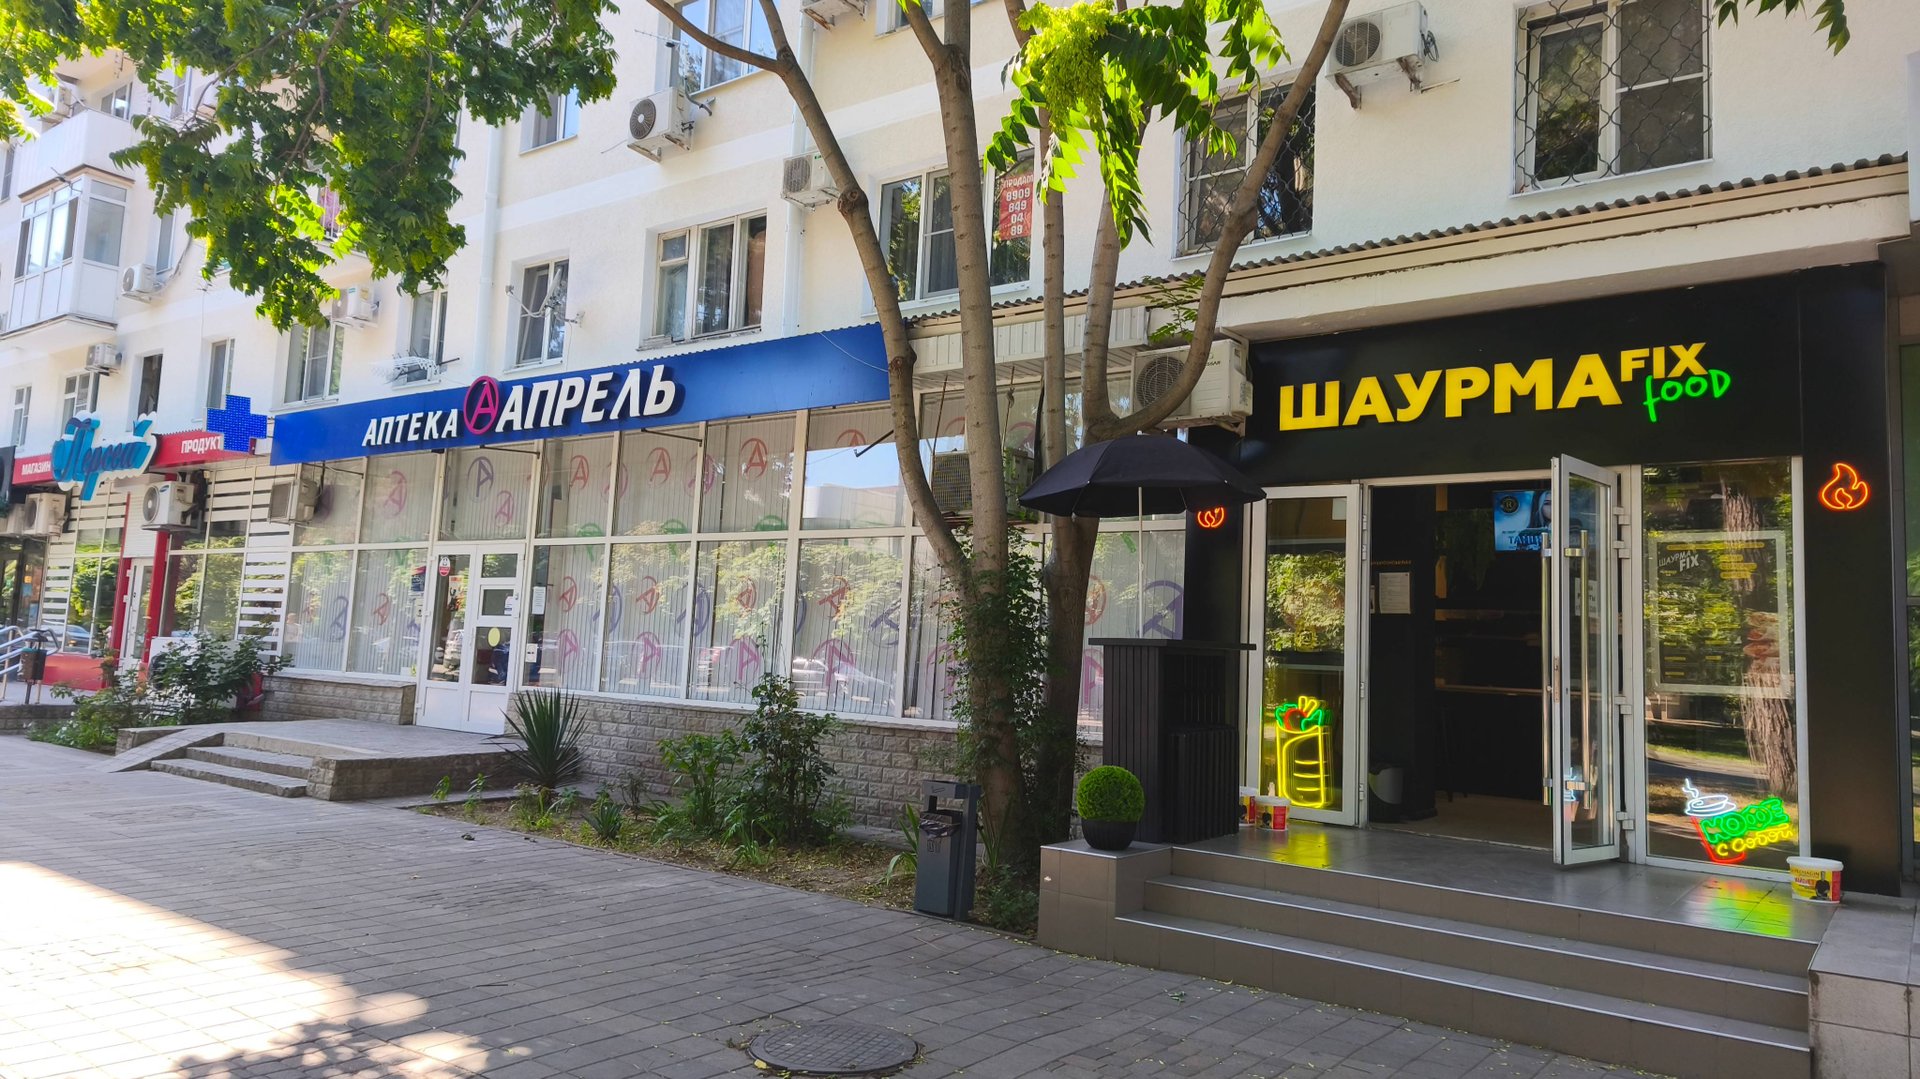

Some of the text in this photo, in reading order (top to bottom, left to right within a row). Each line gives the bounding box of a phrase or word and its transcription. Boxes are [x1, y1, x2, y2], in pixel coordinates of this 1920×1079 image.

[1006, 187, 1030, 201] 8909
[1011, 212, 1024, 224] 04
[1279, 353, 1623, 432] ШАУРМА
[1620, 342, 1708, 383] FIX
[361, 408, 458, 447] АПТЕКА
[495, 364, 676, 433] АПРЕЛЬ
[1679, 554, 1700, 572] FIX
